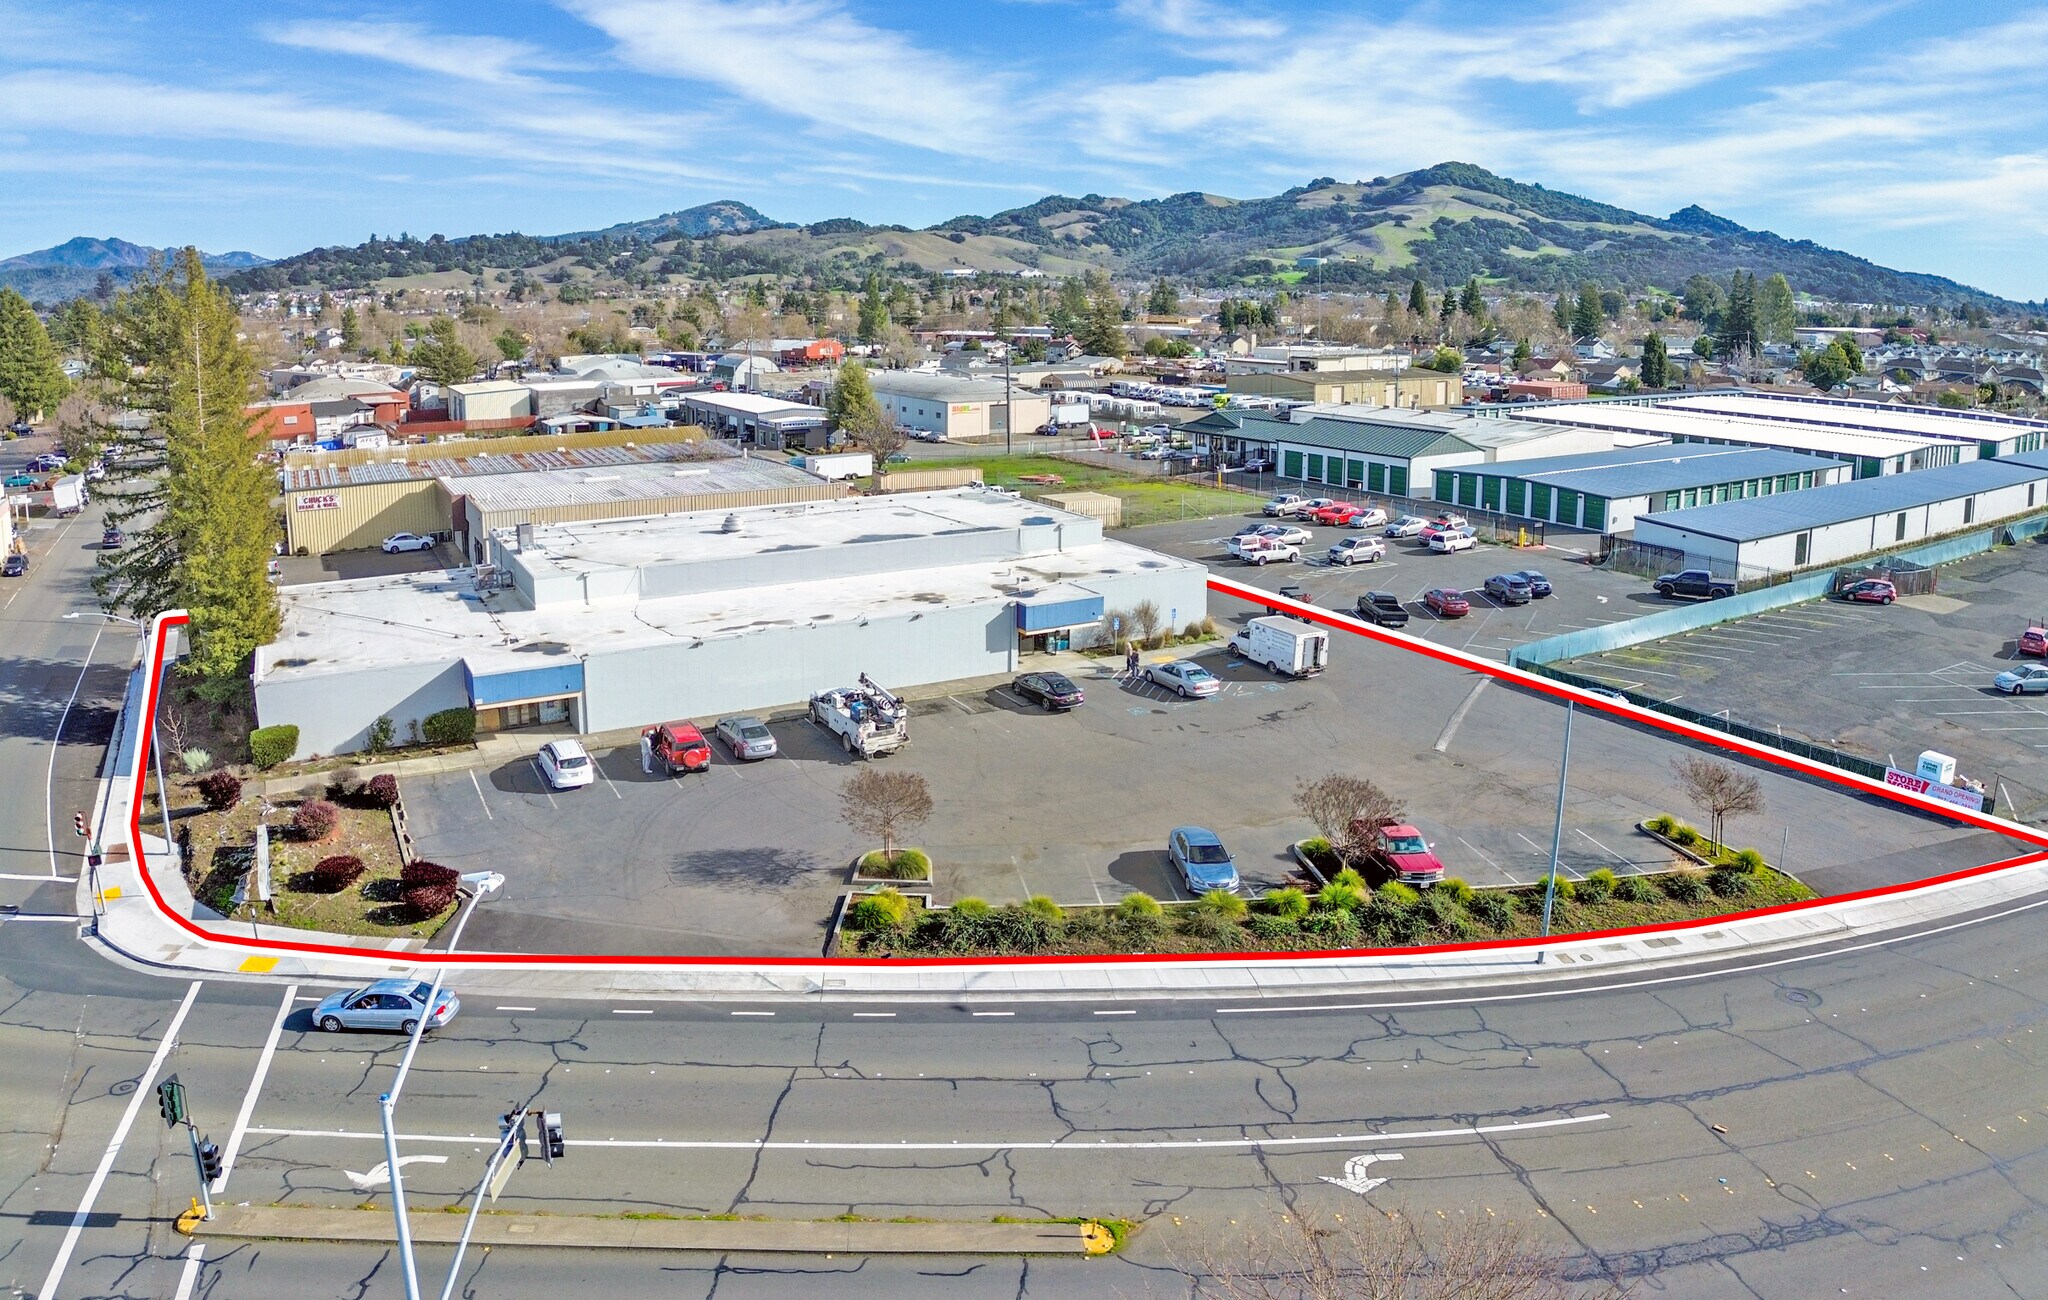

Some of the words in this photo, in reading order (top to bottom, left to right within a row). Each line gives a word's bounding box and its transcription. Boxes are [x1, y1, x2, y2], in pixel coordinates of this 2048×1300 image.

[303, 495, 334, 504] CHUCK'S
[1887, 771, 1921, 789] STORE
[1932, 785, 1953, 797] GRAND
